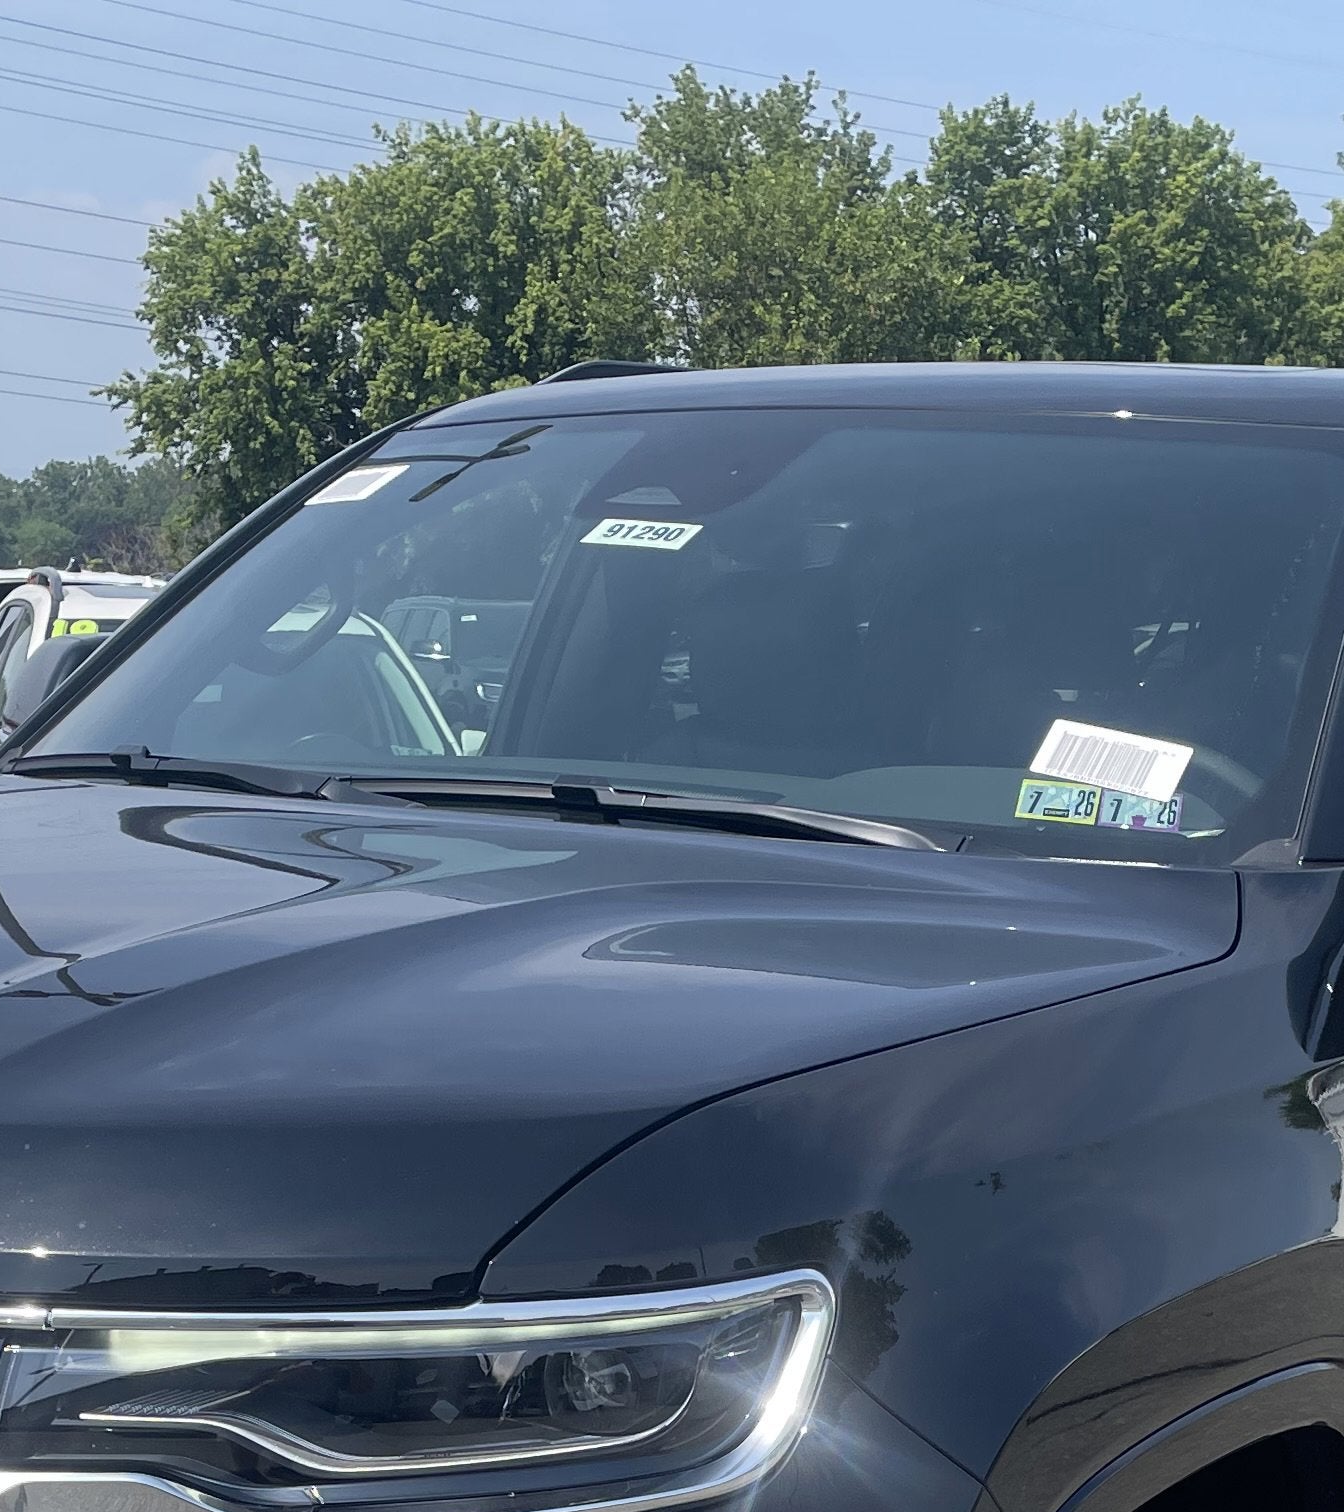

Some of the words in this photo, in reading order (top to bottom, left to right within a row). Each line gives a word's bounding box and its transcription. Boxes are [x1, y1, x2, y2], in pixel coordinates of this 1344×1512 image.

[602, 523, 686, 542] 91290
[1028, 791, 1043, 813] 7
[1074, 789, 1097, 817] 26
[1110, 798, 1122, 822] 7
[1157, 799, 1178, 825] 26
